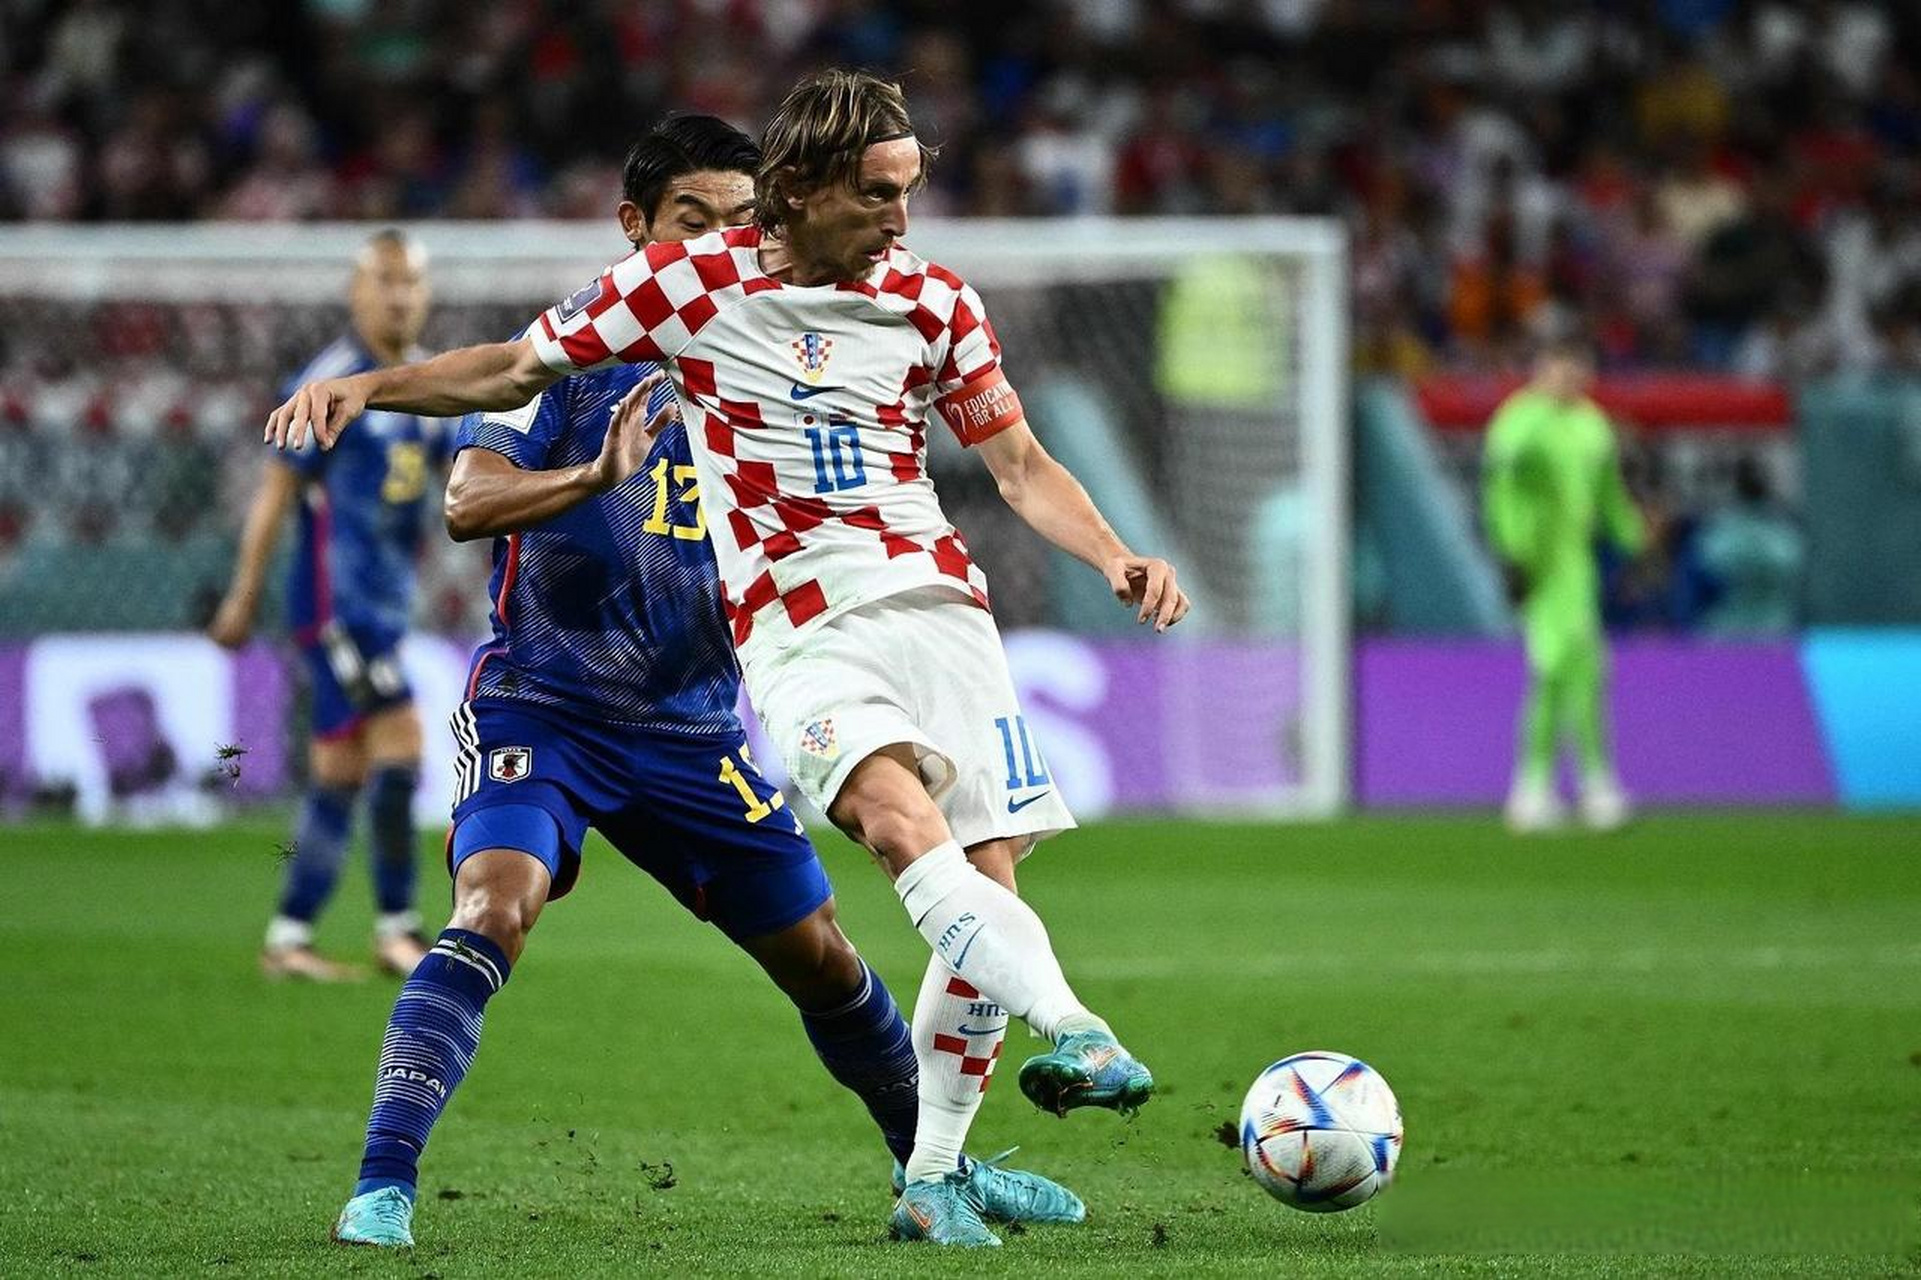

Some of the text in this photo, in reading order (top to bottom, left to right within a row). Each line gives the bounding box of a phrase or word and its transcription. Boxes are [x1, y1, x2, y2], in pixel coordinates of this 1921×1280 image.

[971, 396, 1015, 429] FOR ALL
[804, 425, 867, 494] 10
